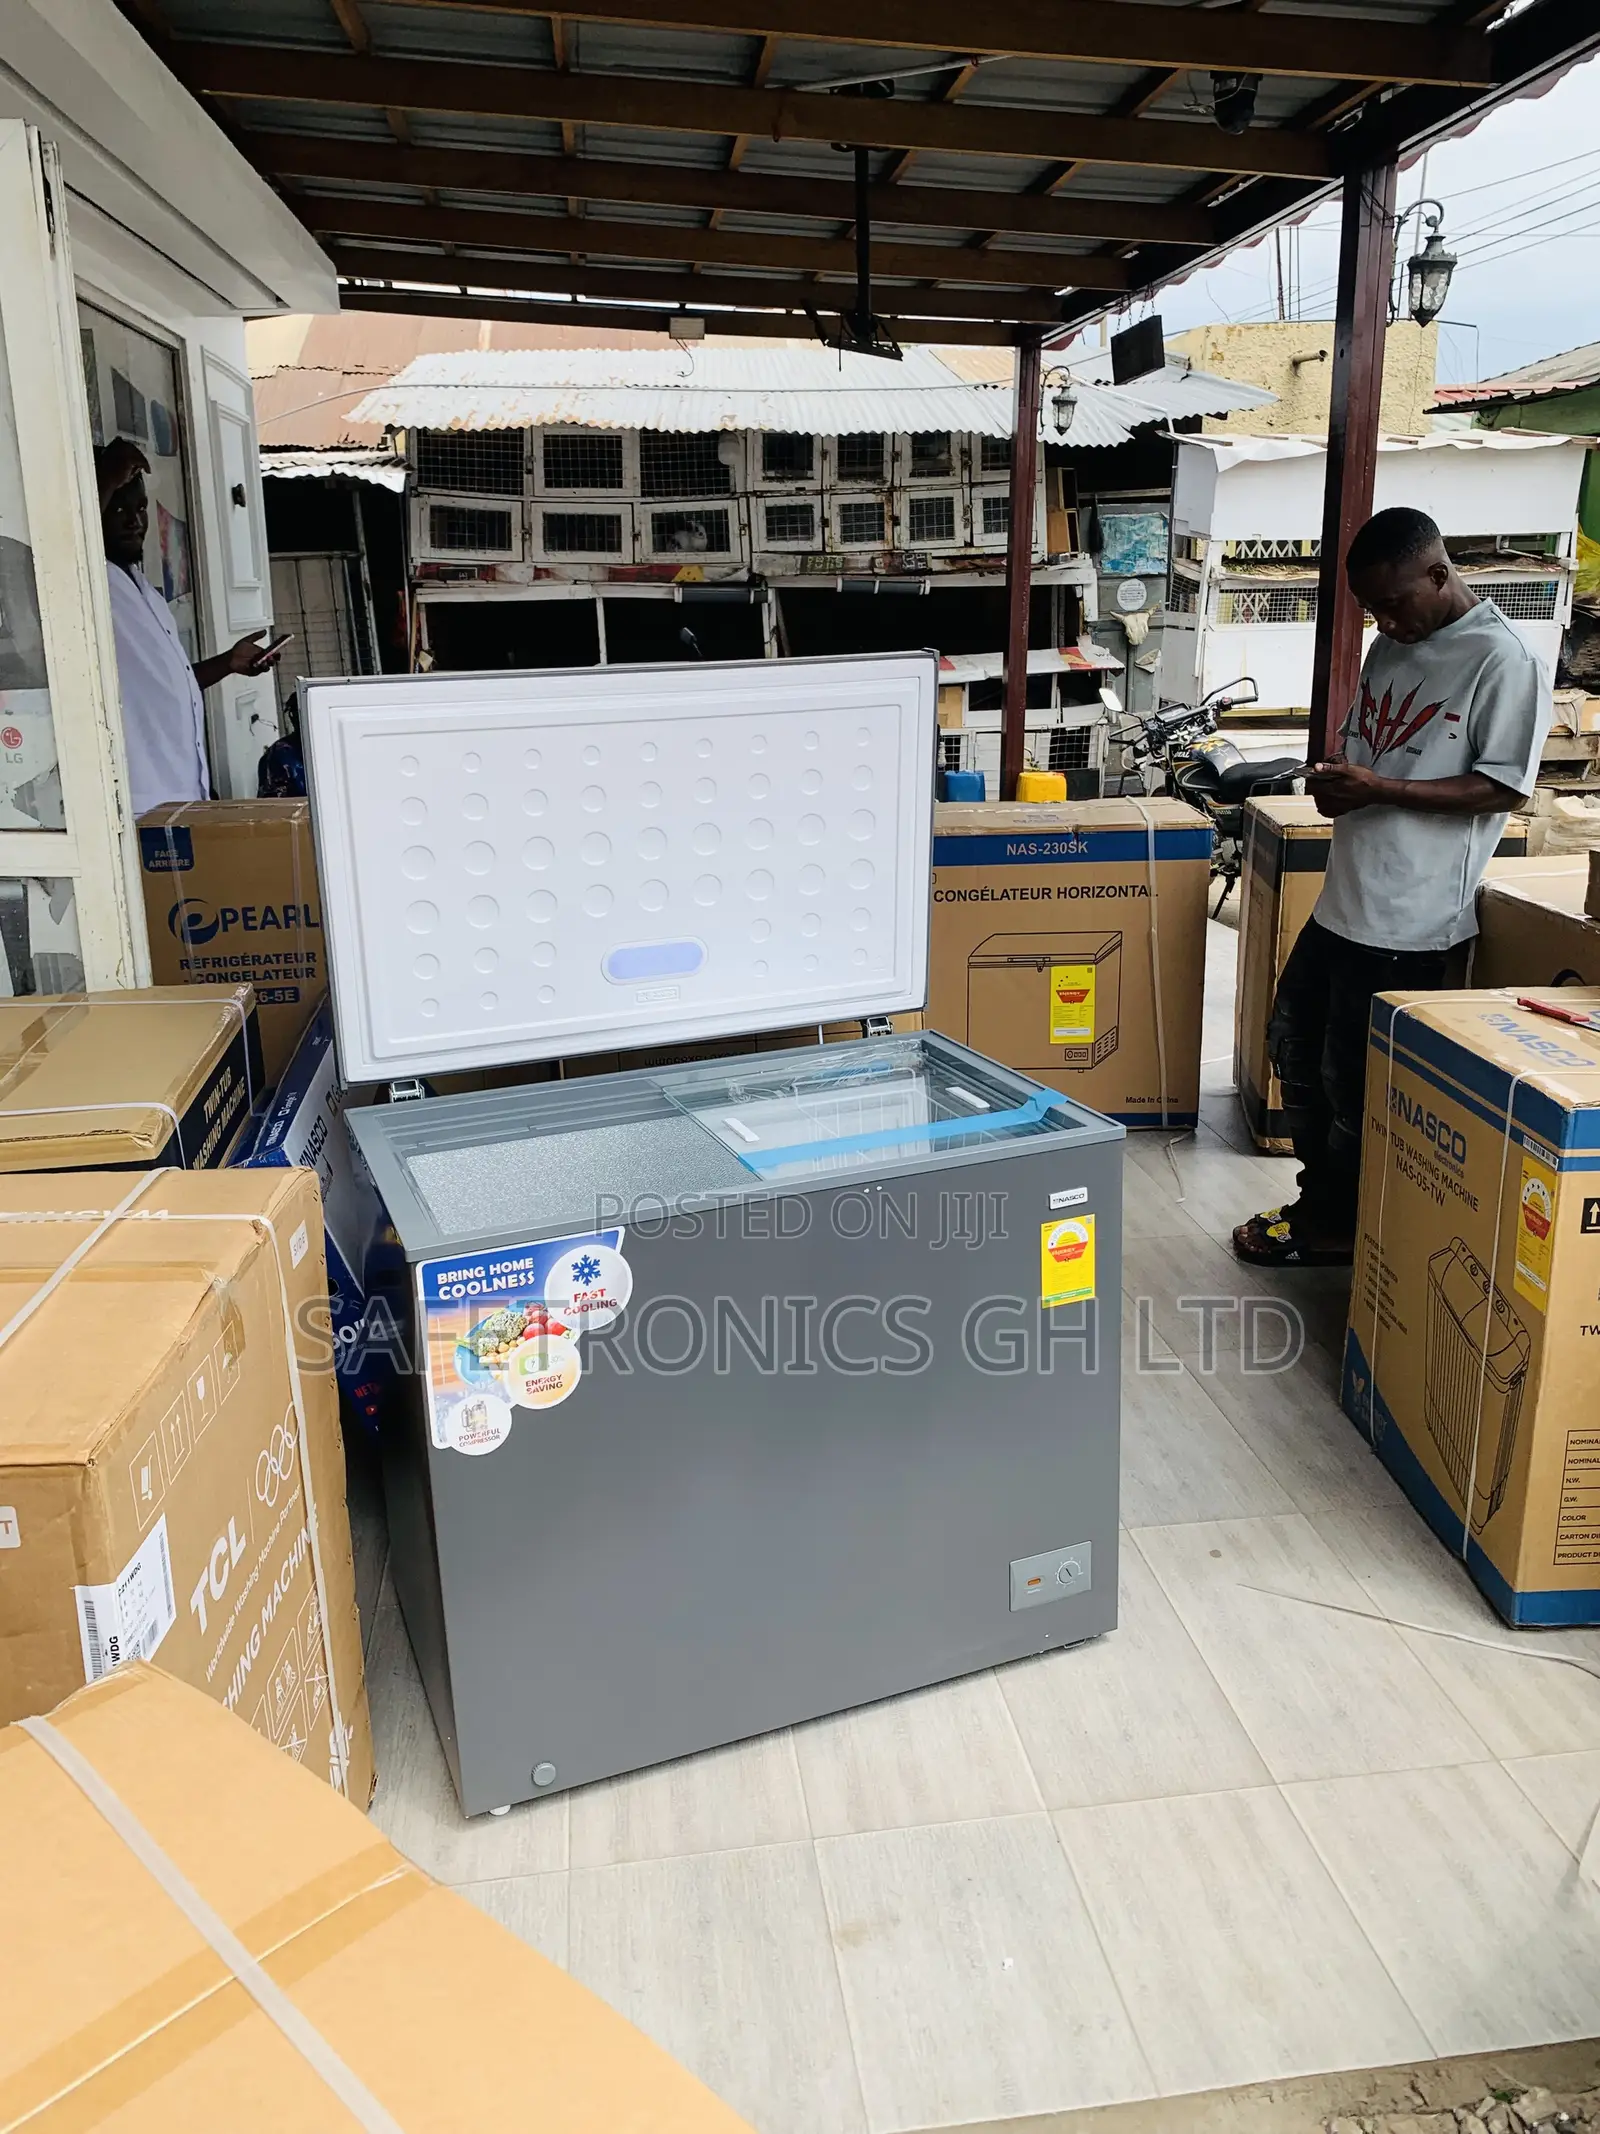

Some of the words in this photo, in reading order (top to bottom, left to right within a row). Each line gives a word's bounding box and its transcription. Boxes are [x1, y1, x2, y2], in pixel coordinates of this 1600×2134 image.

[6, 753, 23, 763] LG
[1006, 841, 1088, 856] NAS-230SK
[934, 886, 1052, 903] CONGÉLATEUR
[1057, 884, 1158, 899] HORIZONTA
[220, 904, 320, 932] PEARL
[1488, 1022, 1596, 1067] NASCO
[221, 1076, 245, 1132] MACHINE
[1125, 1096, 1146, 1104] Made
[1156, 1096, 1179, 1104] Cina
[1397, 1090, 1467, 1165] NASCO
[304, 1115, 328, 1169] NASCO
[1391, 1132, 1405, 1152] TUB
[1406, 1143, 1440, 1181] WASHING
[1442, 1172, 1479, 1213] MACHINE
[1396, 1154, 1446, 1207] NAS-05-TW
[1057, 1193, 1085, 1204] NASCO
[437, 1266, 486, 1286] BRING
[489, 1257, 534, 1276] HOME
[438, 1271, 535, 1300] COOLNESS
[563, 1298, 618, 1316] COOLING
[573, 1288, 607, 1303] FAST
[525, 1374, 563, 1388] ENERGY
[526, 1381, 563, 1395] SAVING
[458, 1428, 501, 1442] POWERFUL
[1559, 1533, 1590, 1541] CARTON
[190, 1516, 247, 1636] TCL
[261, 1503, 319, 1637] MACHIN
[206, 1614, 236, 1683] Worldwide
[234, 1566, 260, 1616] Washing
[258, 1522, 281, 1568] Machine
